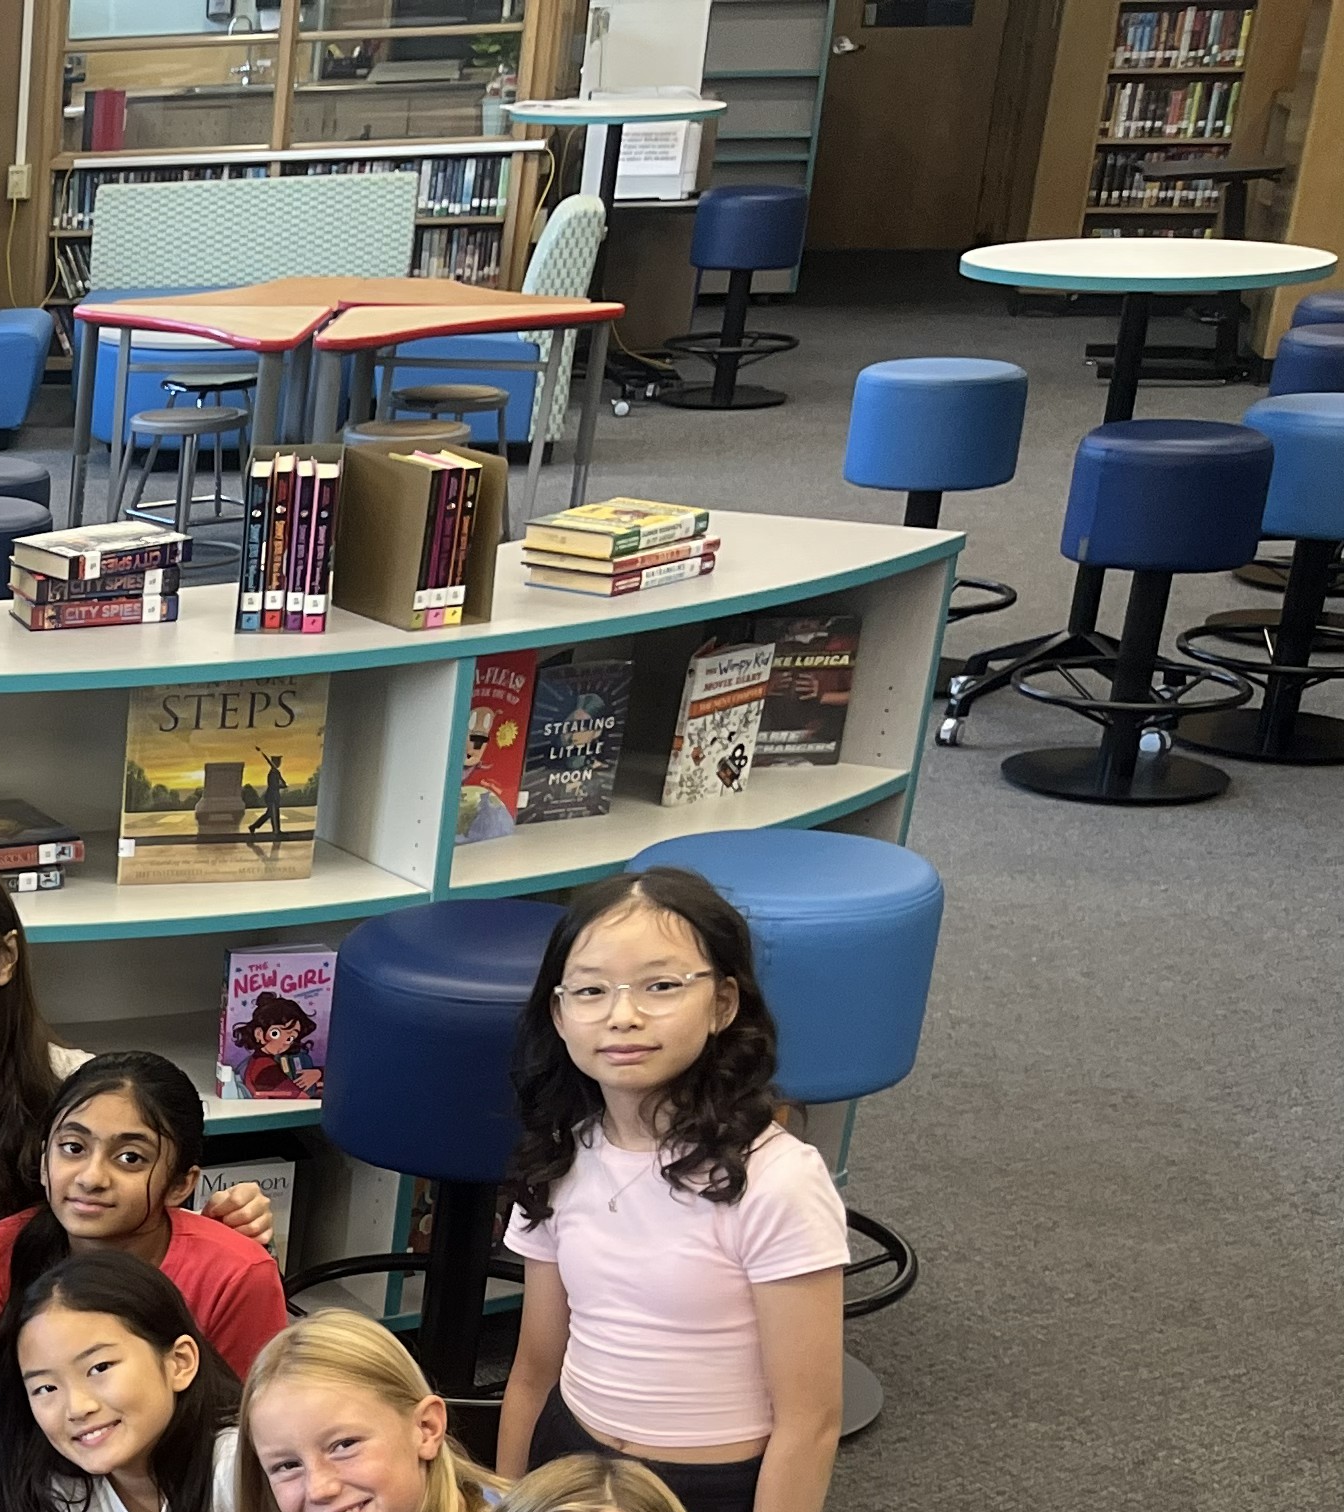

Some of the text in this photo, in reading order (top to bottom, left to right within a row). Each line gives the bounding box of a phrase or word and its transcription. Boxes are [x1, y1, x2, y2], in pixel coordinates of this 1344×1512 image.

[101, 551, 162, 573] CITY SPIES
[70, 573, 144, 594] CITY SPIES
[65, 603, 142, 620] CITY SPIES
[718, 657, 752, 676] Wimpy
[752, 651, 772, 669] Kid
[795, 655, 850, 667] LUPICA
[158, 690, 297, 733] STEPS
[543, 716, 615, 737] STEALING
[549, 742, 605, 760] LITTLE
[548, 769, 593, 786] MOON
[248, 961, 269, 973] THE
[233, 970, 277, 999] NEW
[280, 968, 331, 994] GIRL
